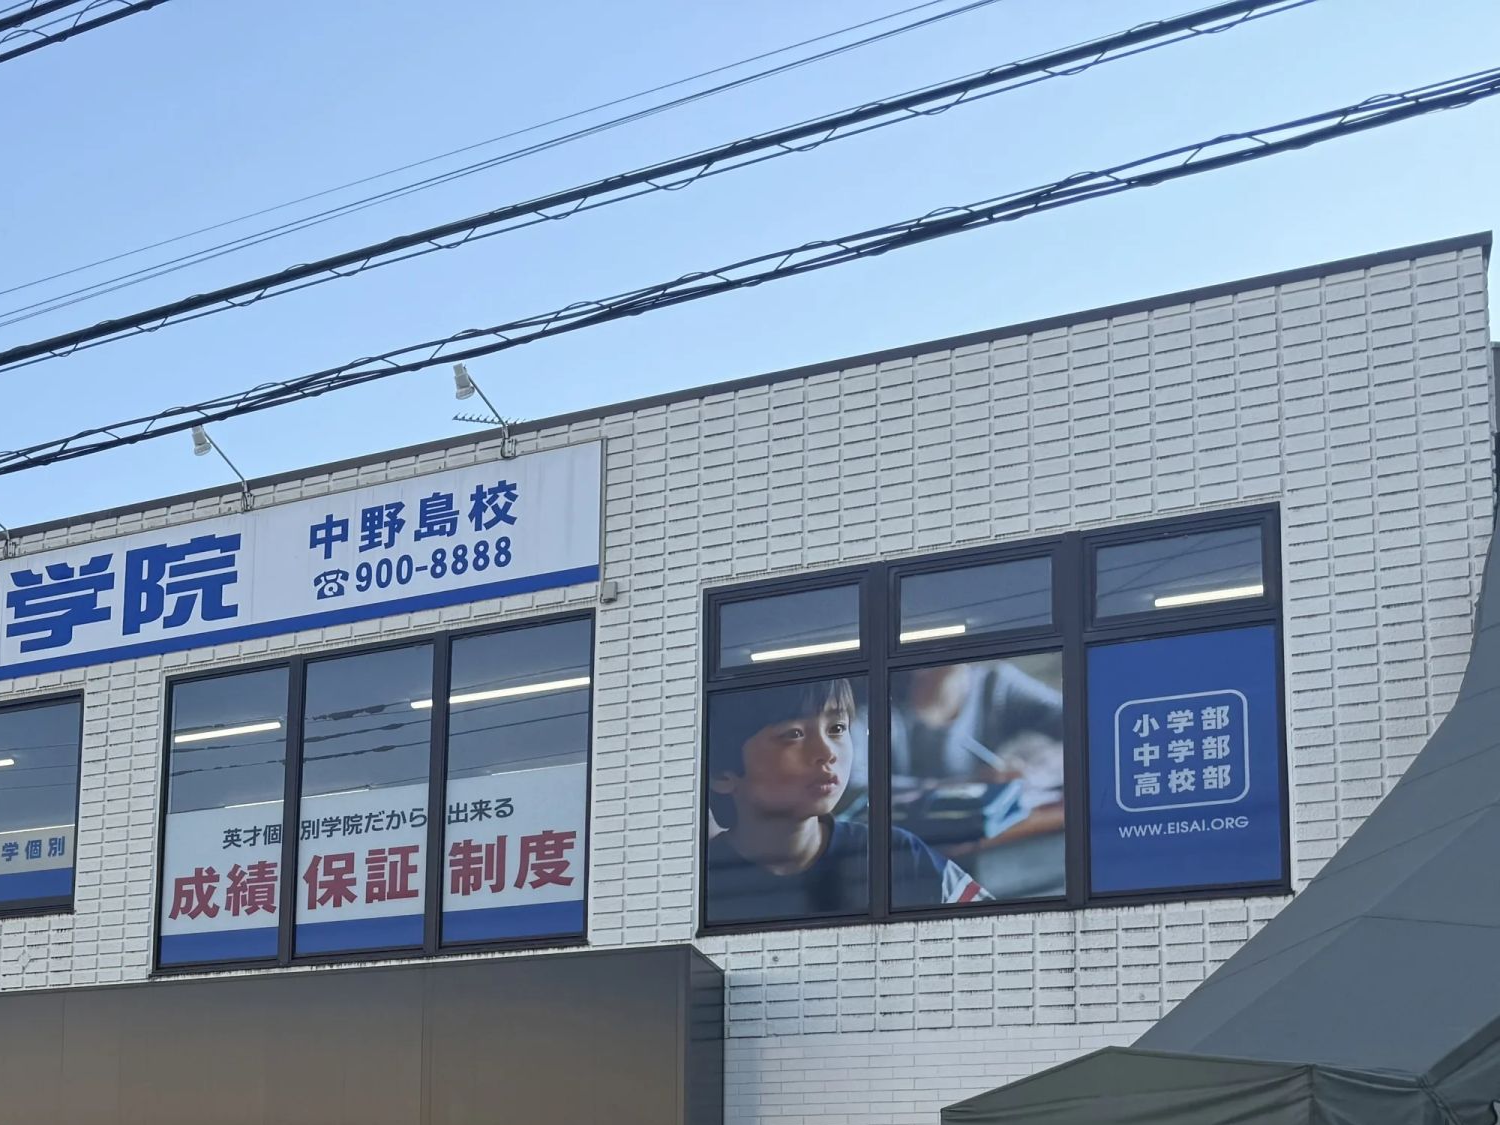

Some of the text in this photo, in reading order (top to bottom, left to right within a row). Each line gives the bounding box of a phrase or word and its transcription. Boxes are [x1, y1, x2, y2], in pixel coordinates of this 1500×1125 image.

[308, 480, 520, 561] 中野島校
[354, 536, 512, 593] 900-8888
[1133, 705, 1230, 739] 小学部
[1133, 735, 1231, 769] 中学部
[1134, 766, 1231, 798] 高校部
[1118, 814, 1250, 838] WWW.EISAI.ORG
